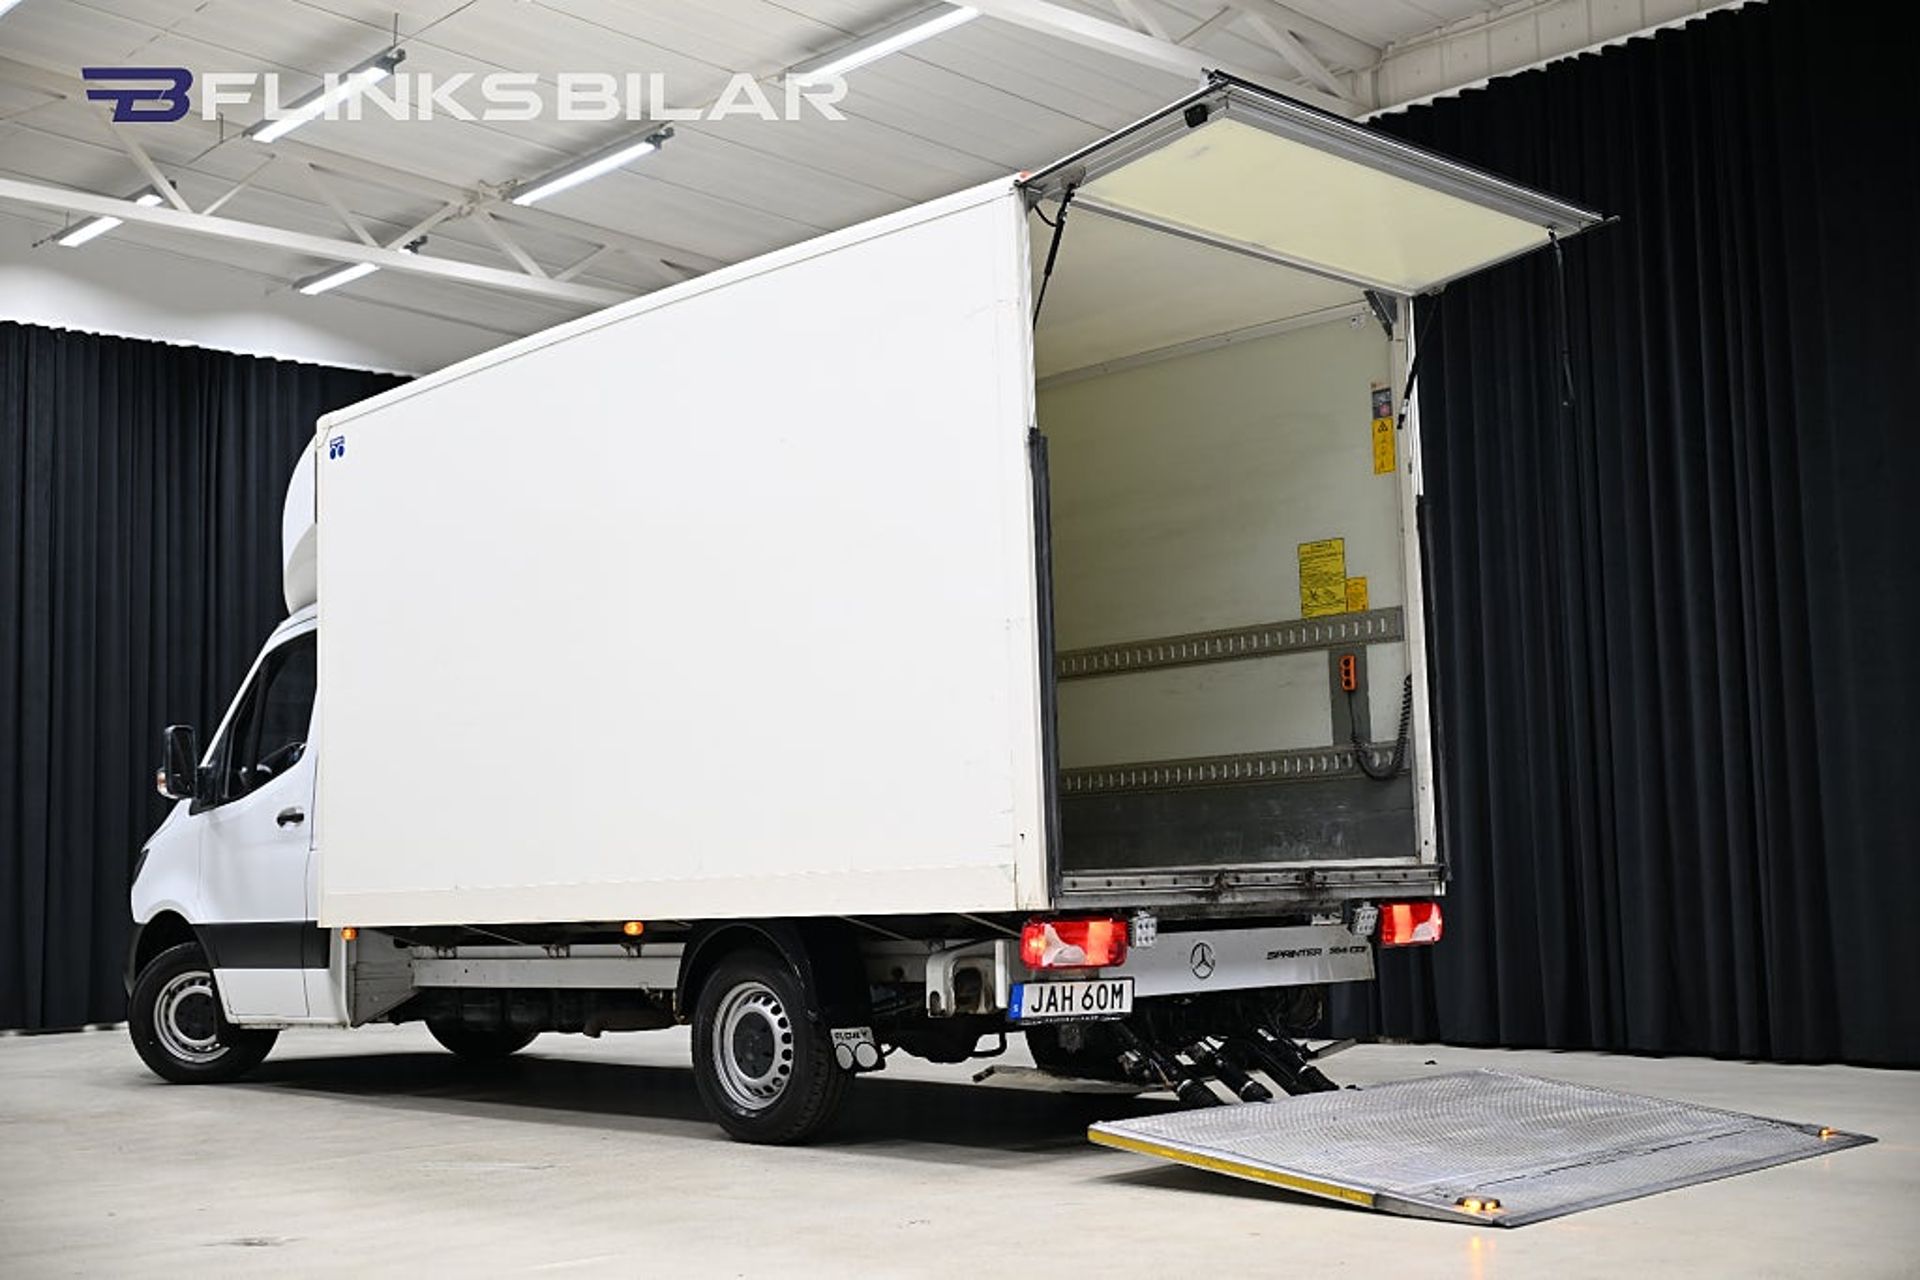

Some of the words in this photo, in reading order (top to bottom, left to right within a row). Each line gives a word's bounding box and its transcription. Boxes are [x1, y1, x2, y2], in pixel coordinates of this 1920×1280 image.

[1266, 947, 1323, 961] SPRINTER
[1031, 985, 1074, 1013] JAH
[1081, 983, 1125, 1010] 60M
